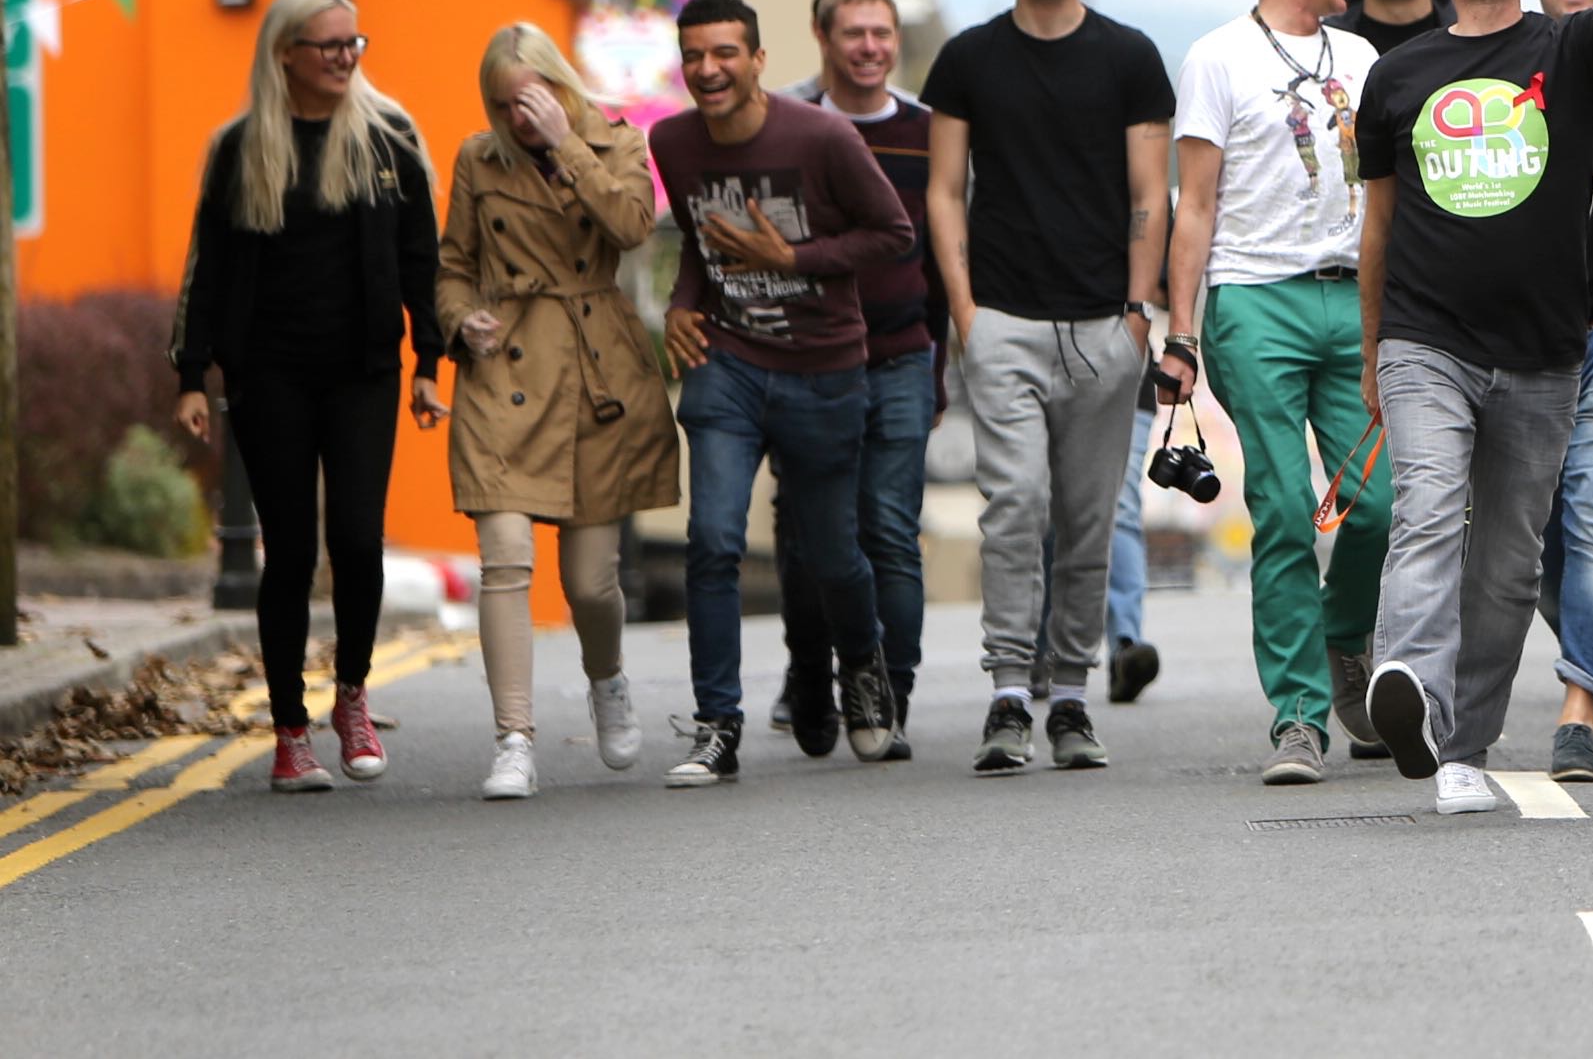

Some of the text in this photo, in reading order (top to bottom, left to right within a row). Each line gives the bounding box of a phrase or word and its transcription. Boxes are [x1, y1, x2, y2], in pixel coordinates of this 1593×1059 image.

[1420, 139, 1437, 149] THE
[1425, 145, 1541, 181] OUTING
[1462, 182, 1489, 191] World's
[1467, 189, 1515, 199] Matchmaking
[1462, 200, 1482, 208] Music
[1483, 197, 1511, 207] Festival
